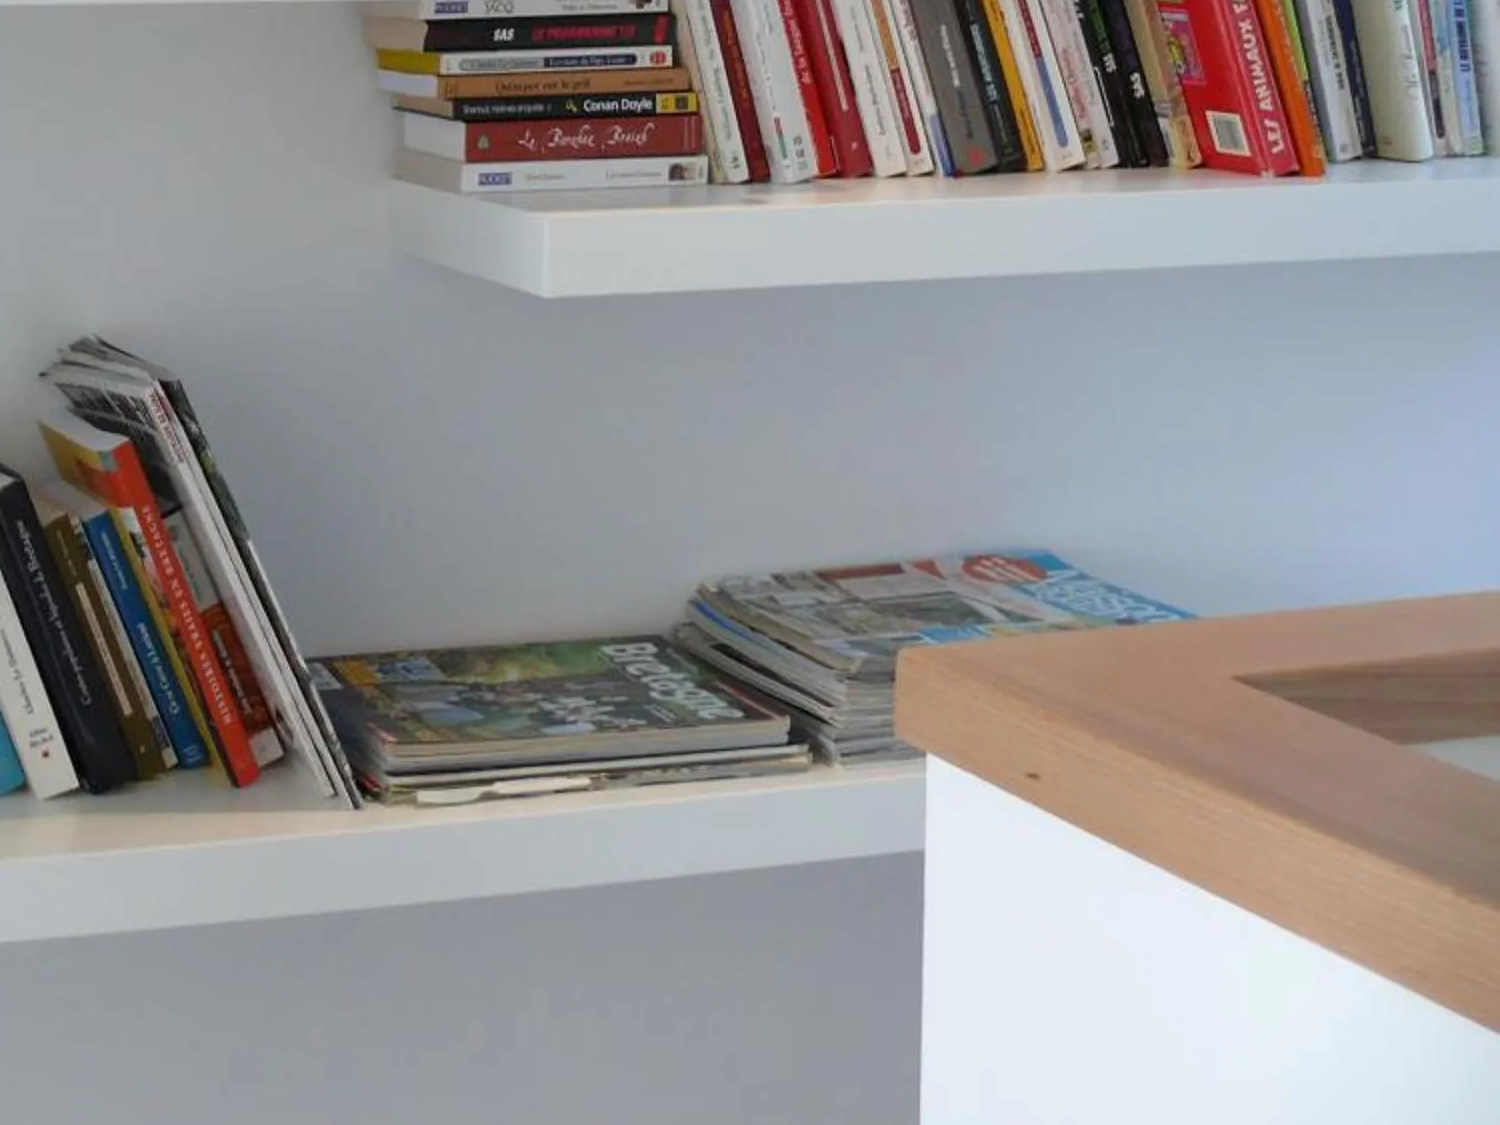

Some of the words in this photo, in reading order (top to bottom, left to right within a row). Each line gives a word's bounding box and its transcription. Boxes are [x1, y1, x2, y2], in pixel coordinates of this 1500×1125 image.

[492, 28, 515, 41] SAS
[1237, 18, 1275, 113] ANIMAUX
[1128, 71, 1146, 99] SAS
[583, 97, 617, 112] Conan
[619, 95, 652, 111] Doyle
[1263, 117, 1285, 154] LES
[601, 643, 744, 720] Bretagne
